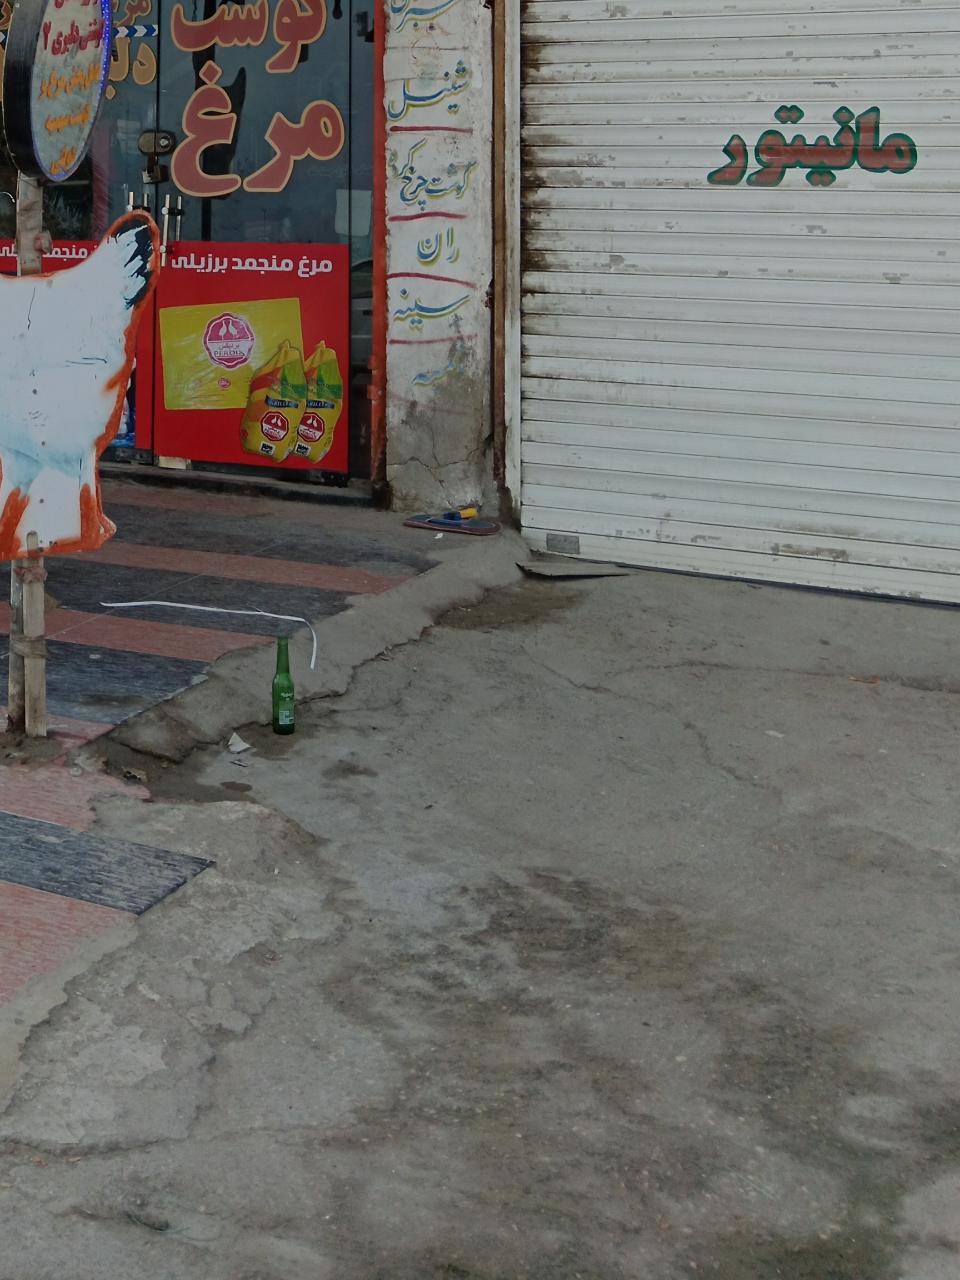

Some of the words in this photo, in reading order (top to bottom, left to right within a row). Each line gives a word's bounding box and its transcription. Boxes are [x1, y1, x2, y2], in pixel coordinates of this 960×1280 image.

[170, 60, 345, 198] مرغ
[706, 105, 918, 188] مانیتور
[171, 255, 229, 274] برزیلی
[232, 256, 294, 275] منجمد
[297, 256, 334, 278] مرغ
